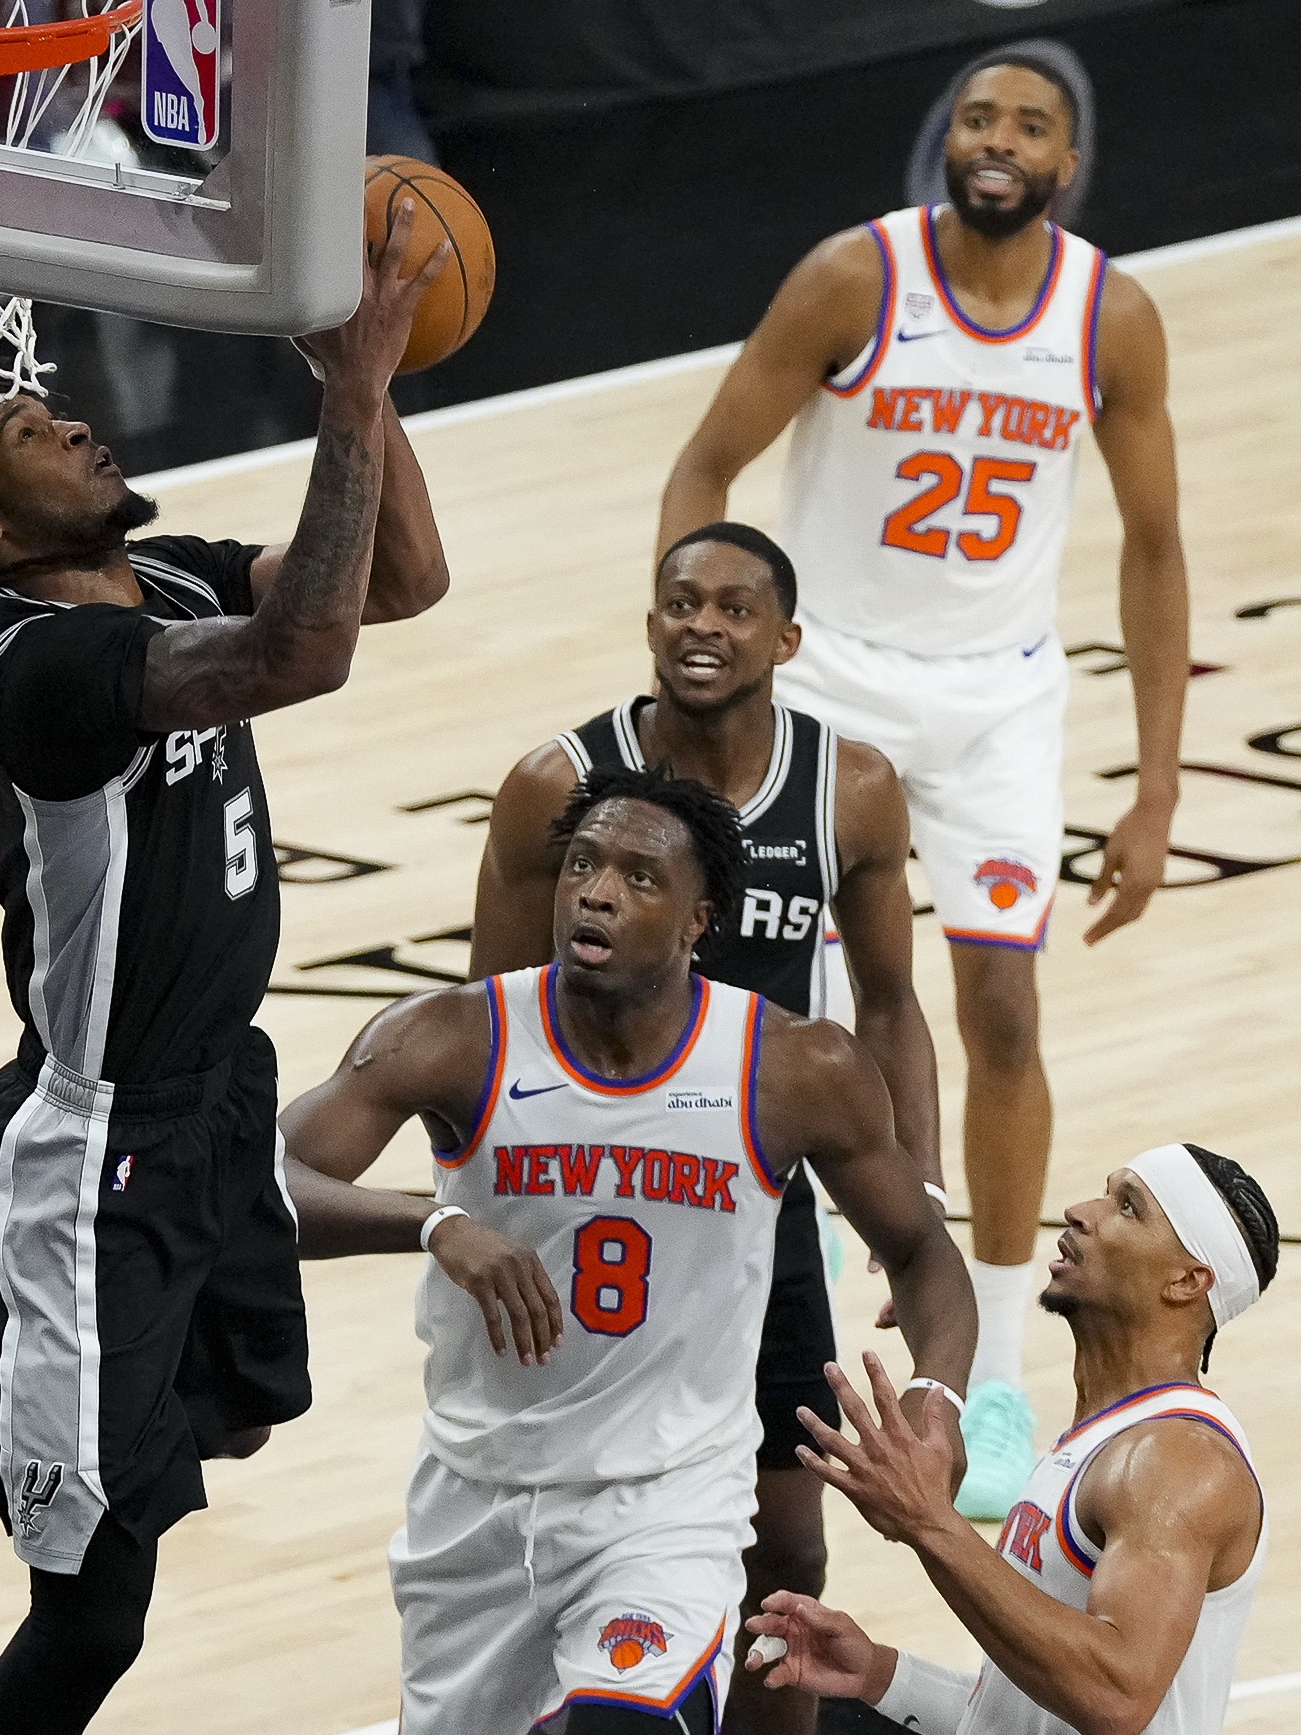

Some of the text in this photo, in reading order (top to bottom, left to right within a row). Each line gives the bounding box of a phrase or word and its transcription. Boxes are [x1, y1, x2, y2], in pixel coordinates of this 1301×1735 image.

[154, 91, 190, 132] NBA
[866, 387, 1081, 451] NEW YORK
[880, 448, 1038, 562] 25
[223, 785, 259, 901] 5
[749, 845, 799, 860] LEDGER
[667, 1096, 733, 1109] abu dhabi
[493, 1143, 740, 1214] NEW YORK
[570, 1214, 653, 1338] 8
